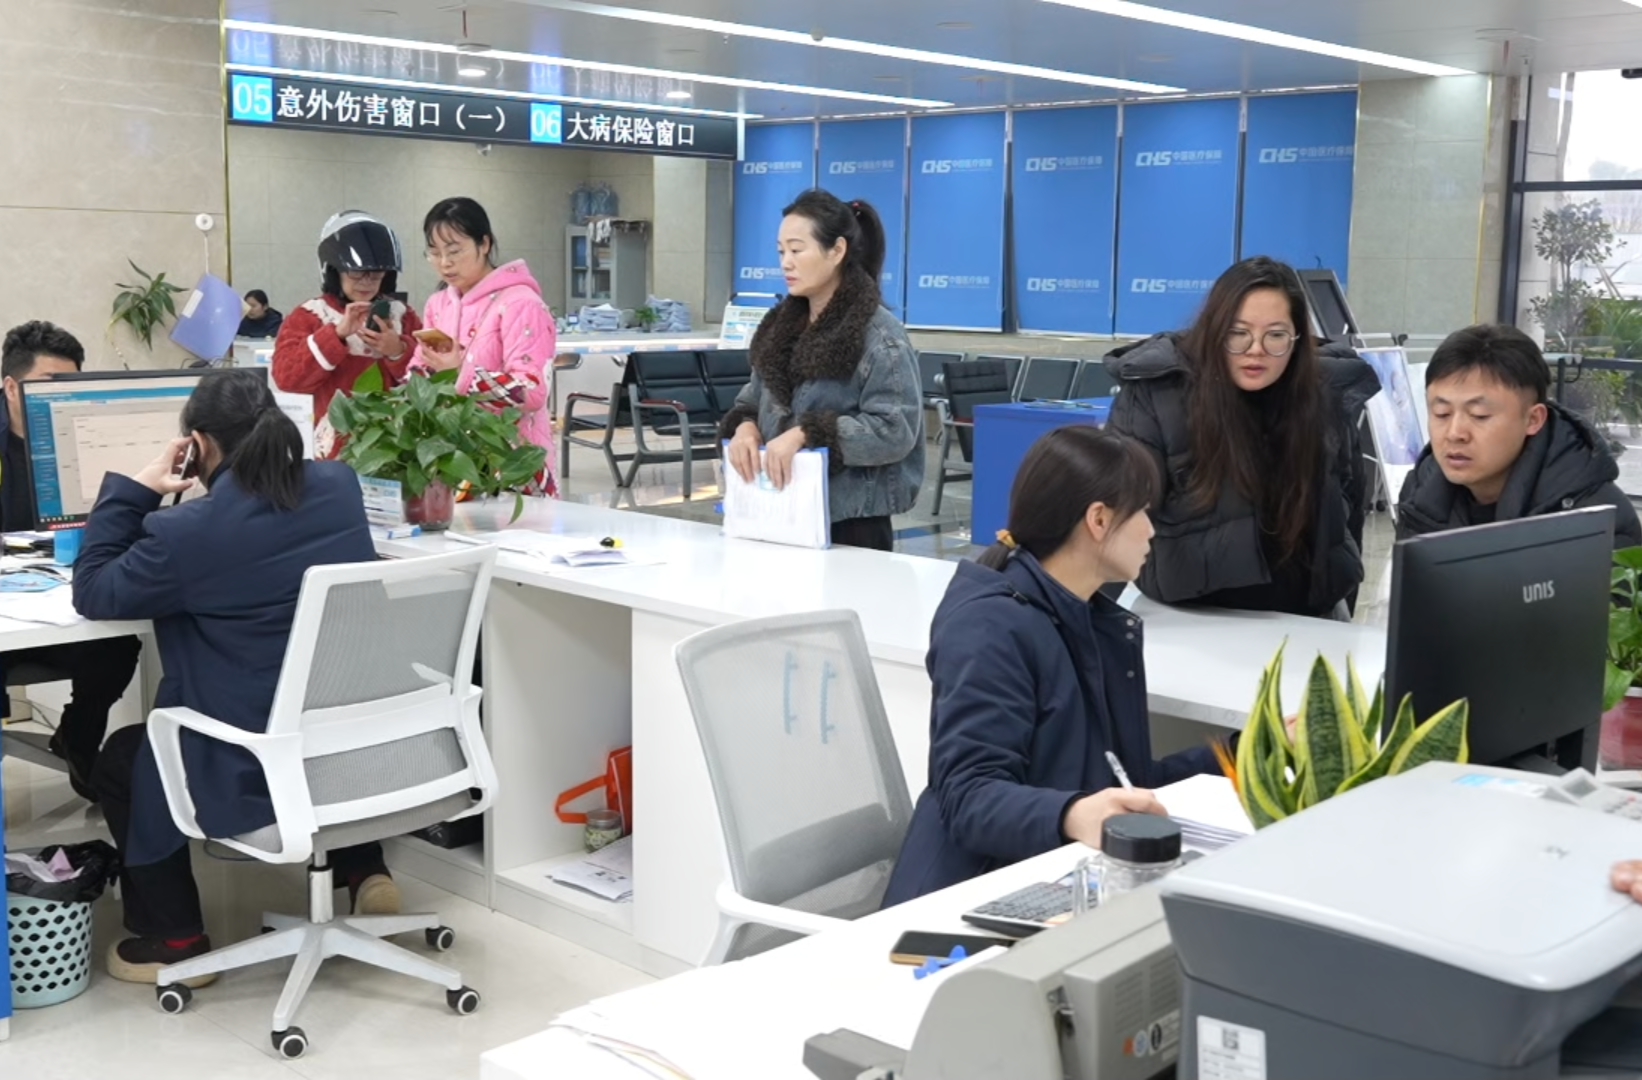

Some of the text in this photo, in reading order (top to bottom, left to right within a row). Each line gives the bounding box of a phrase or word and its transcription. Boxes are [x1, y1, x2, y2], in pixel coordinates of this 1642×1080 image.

[233, 81, 271, 116] 05
[277, 85, 506, 132] 意外伤害窗口（一）
[531, 108, 561, 138] 06
[566, 111, 695, 147] 大病保险窗口
[1135, 151, 1172, 166] CHS
[1258, 148, 1298, 163] CHS
[921, 159, 951, 173] CHS
[1025, 157, 1057, 171] CHS
[918, 275, 948, 288] CHS
[1027, 277, 1057, 291] CHS
[1131, 278, 1167, 293] CHS
[1523, 580, 1555, 603] UNIS
